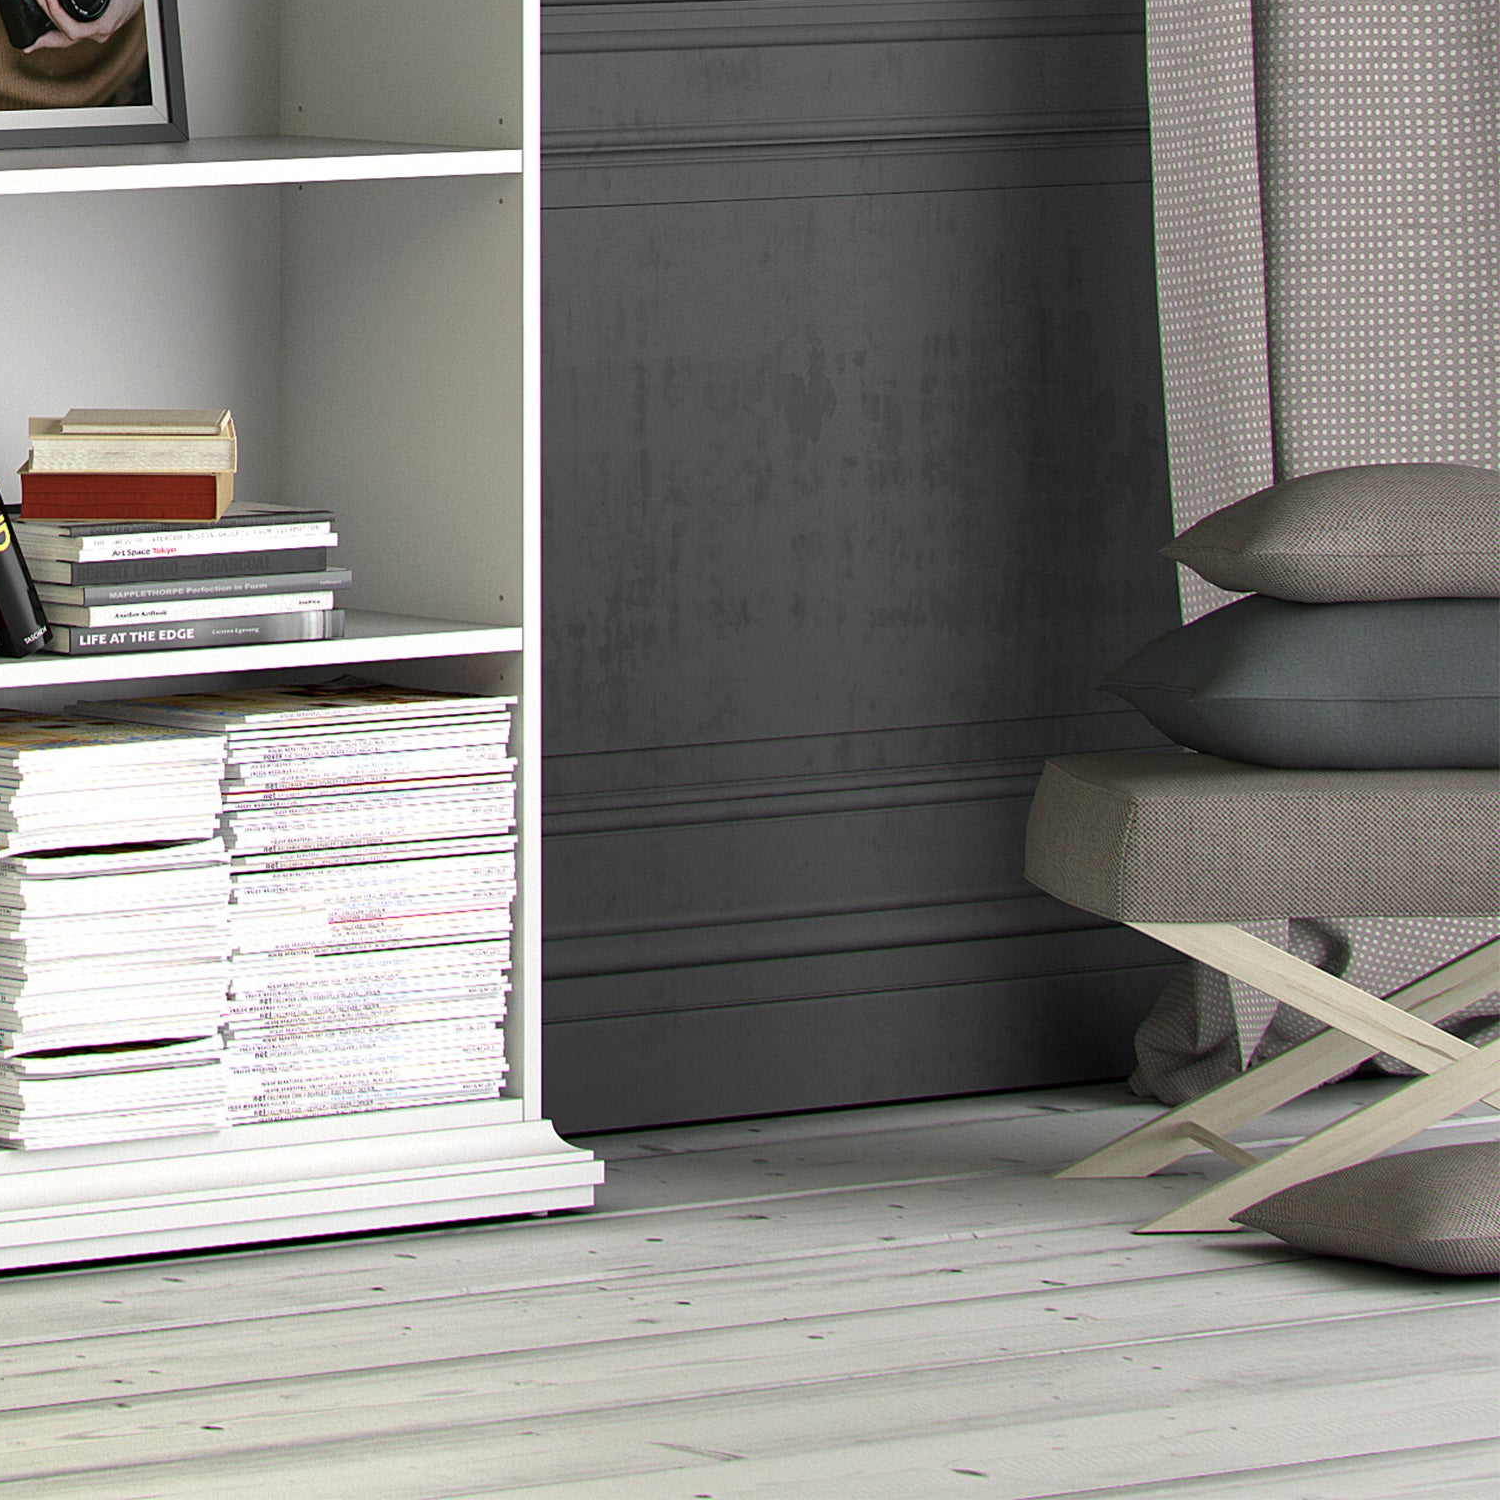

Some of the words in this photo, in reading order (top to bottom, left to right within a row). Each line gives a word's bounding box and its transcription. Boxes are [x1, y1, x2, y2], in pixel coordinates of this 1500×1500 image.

[111, 549, 125, 557] Art
[127, 548, 151, 557] Space
[152, 546, 177, 555] Tokyo
[109, 588, 184, 599] MAPPLETHORPE
[186, 584, 232, 594] Perfection
[244, 582, 267, 590] Form
[23, 626, 48, 646] TASCHEN
[79, 633, 107, 647] LIFE
[109, 632, 127, 645] AT
[129, 630, 155, 643] THE
[158, 628, 195, 641] EDGE
